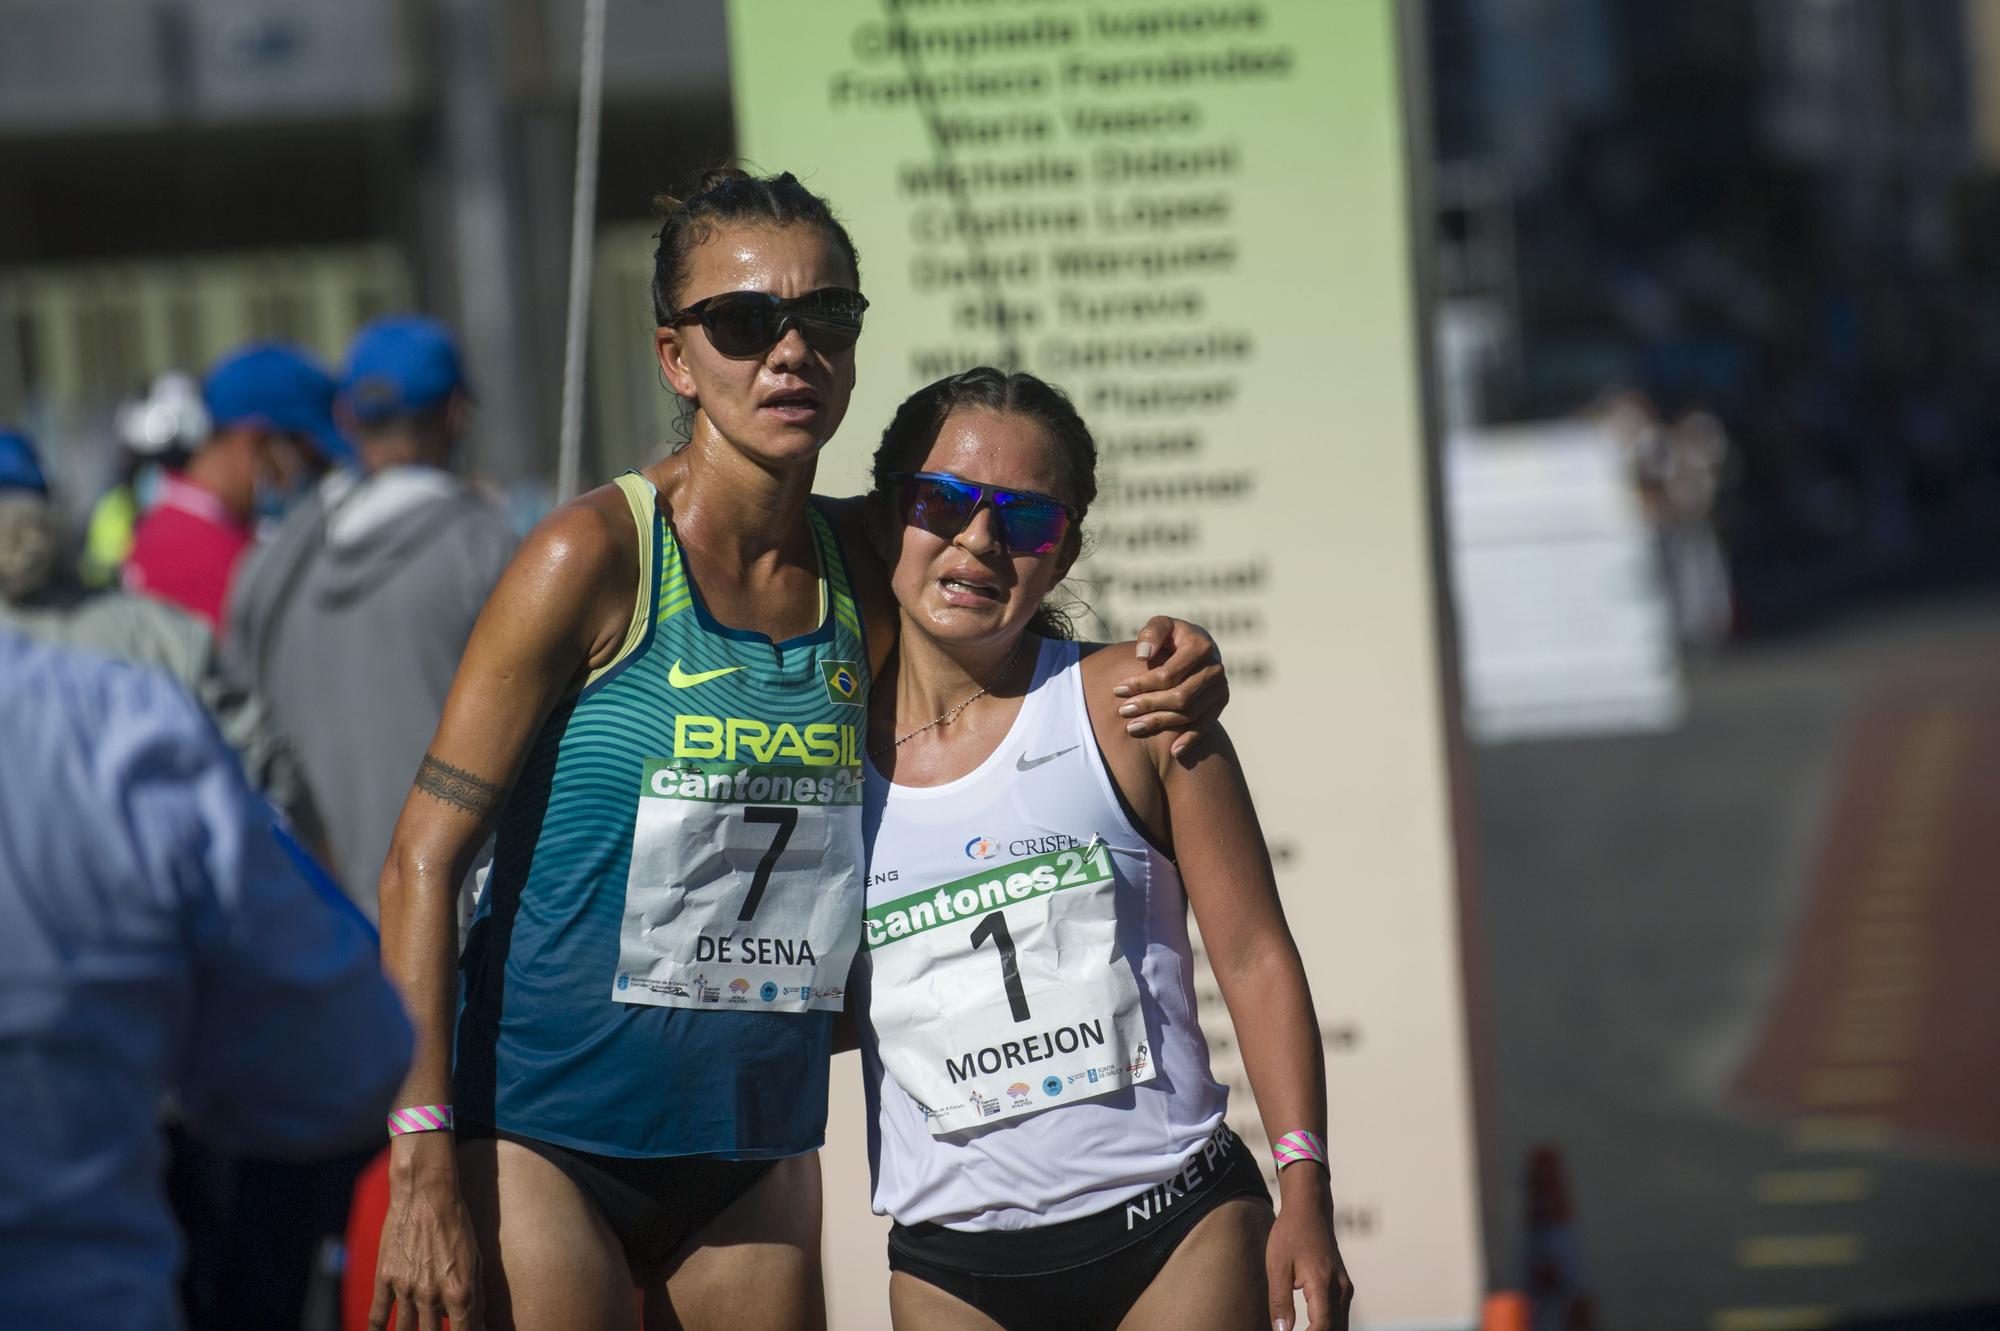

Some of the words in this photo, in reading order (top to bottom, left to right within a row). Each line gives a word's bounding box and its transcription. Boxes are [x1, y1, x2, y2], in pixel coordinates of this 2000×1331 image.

[674, 715, 862, 766] BRASIL
[737, 807, 798, 921] 7
[1009, 834, 1081, 857] CRISFE
[867, 843, 1111, 946] cantones21
[696, 936, 732, 963] DE
[741, 937, 816, 966] SENA
[970, 910, 1031, 1023] 1
[945, 1019, 1105, 1084] MOREJON
[1126, 1155, 1203, 1231] NIKE
